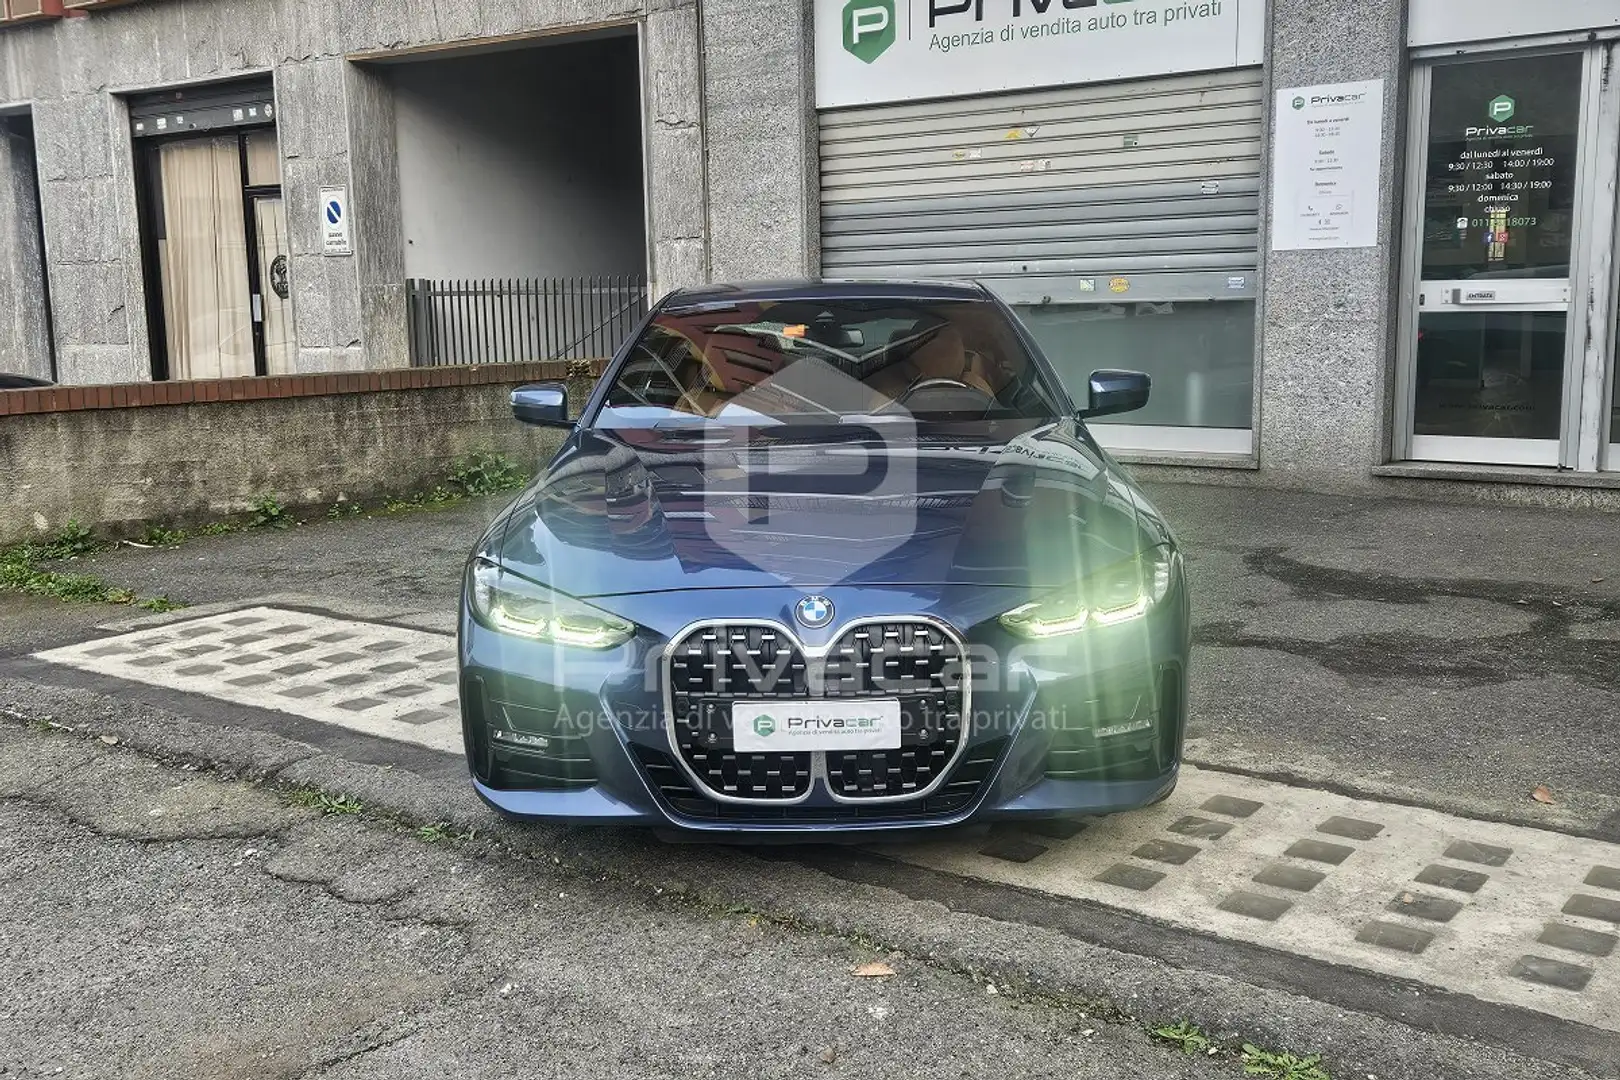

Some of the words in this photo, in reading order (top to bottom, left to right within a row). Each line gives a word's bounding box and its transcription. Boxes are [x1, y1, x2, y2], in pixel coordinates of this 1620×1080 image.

[852, 5, 889, 44] P
[929, 28, 994, 52] Agenzia
[1000, 24, 1014, 41] di
[1020, 17, 1081, 39] vendita
[1088, 13, 1127, 31] auto
[1133, 9, 1157, 25] tra
[1164, 1, 1221, 26] privati
[1311, 94, 1365, 104] Privacar
[1493, 102, 1511, 115] P
[1465, 125, 1534, 137] Privacar
[1460, 151, 1472, 159] dal
[1502, 149, 1509, 157] al
[1448, 162, 1464, 171] 9:30
[1472, 161, 1493, 170] 12:30
[1533, 158, 1554, 166] 19:00
[1486, 171, 1514, 180] sabato
[1530, 180, 1552, 189] 19:00
[1478, 194, 1518, 202] domenica
[788, 715, 880, 729] Privacar
